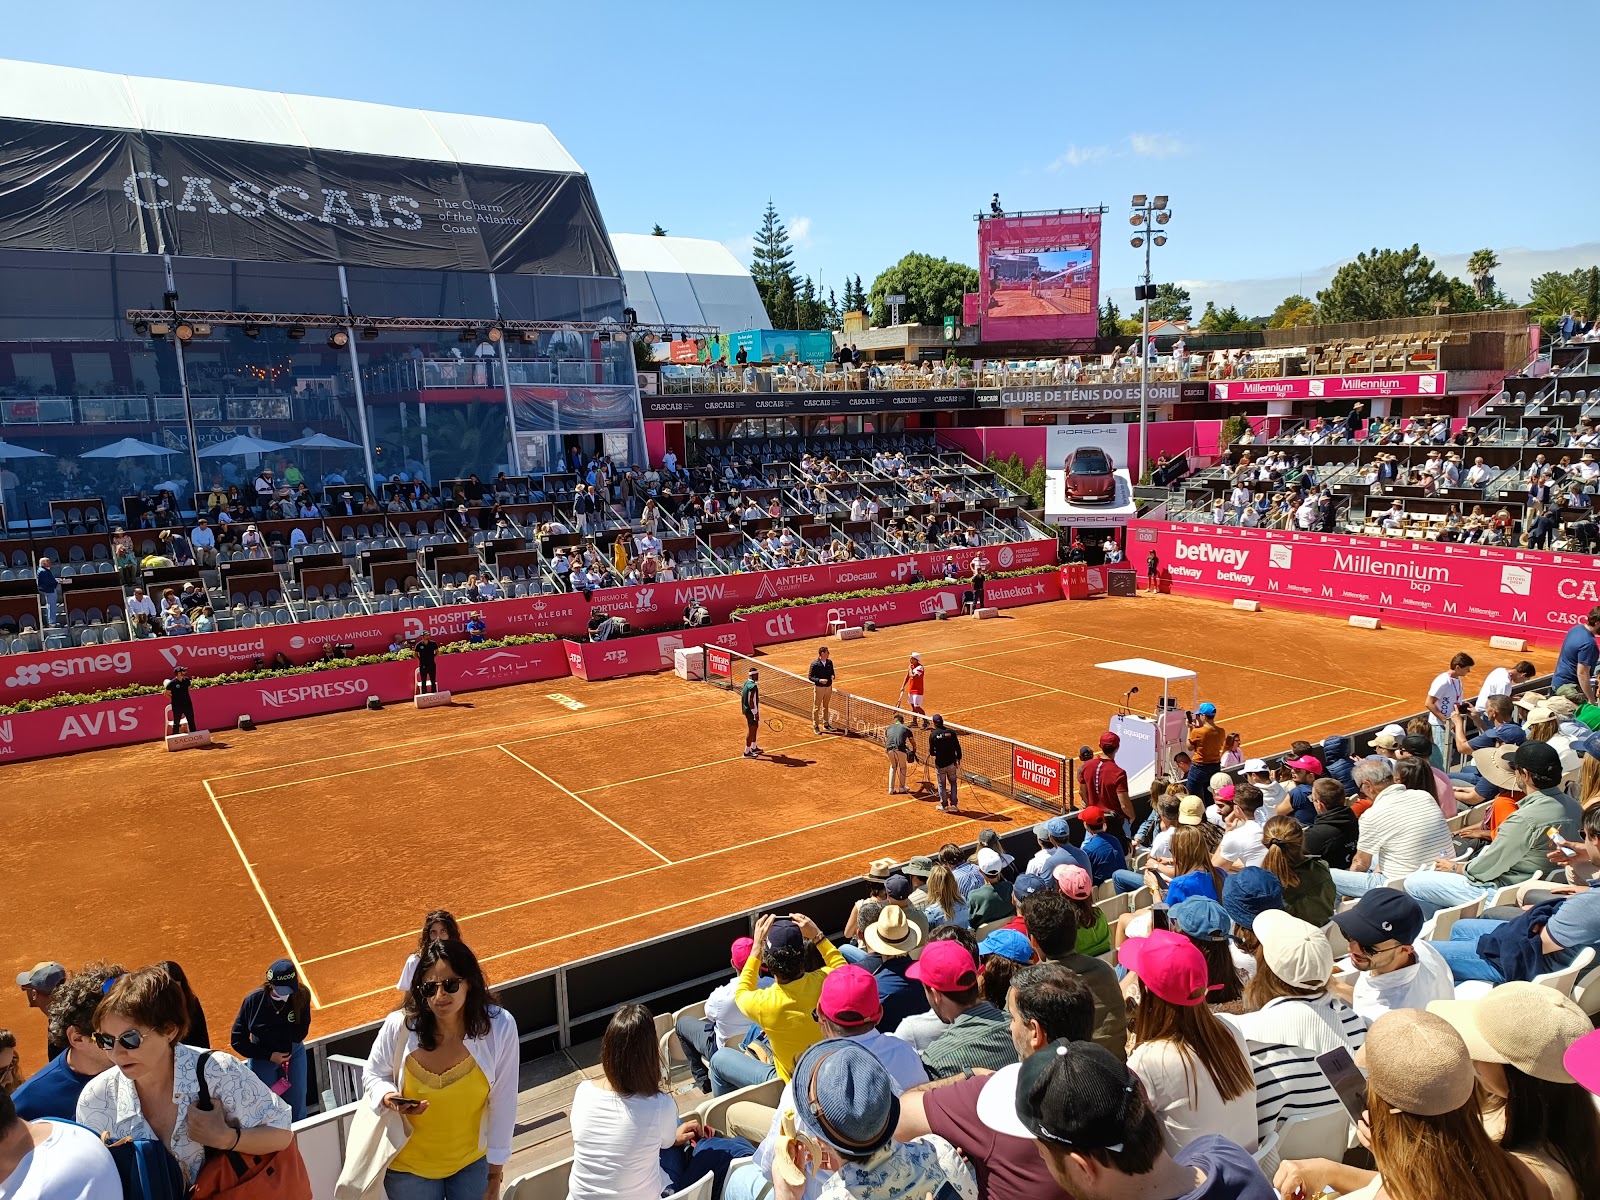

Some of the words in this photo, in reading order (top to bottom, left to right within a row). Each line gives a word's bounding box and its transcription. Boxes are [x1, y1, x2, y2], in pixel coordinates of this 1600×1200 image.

[123, 171, 423, 231] CASCAIS
[434, 198, 460, 209] The
[461, 200, 505, 213] Charm
[438, 211, 452, 221] of
[453, 211, 474, 223] the
[475, 212, 525, 227] Atlantic
[441, 223, 478, 235] Coast
[1242, 382, 1294, 393] Millennium
[1341, 378, 1400, 389] Millennium
[892, 397, 918, 405] CASCAIS
[933, 395, 958, 403] CASCAIS
[976, 394, 999, 403] CASCAIS
[1001, 391, 1042, 403] CLUBE
[1044, 390, 1062, 402] DE
[1063, 387, 1100, 402] TÉNIS
[1102, 388, 1123, 400] DO
[1125, 386, 1180, 400] ESORIL
[650, 402, 683, 411] CASCAIS
[704, 401, 735, 410] CASCAIS
[755, 400, 784, 408] CASCAIS
[803, 399, 831, 407] CASCAIS
[848, 398, 876, 406] CASCAIS
[179, 433, 234, 443] PRTU
[1175, 539, 1250, 570] betway
[1167, 564, 1203, 580] betway
[1333, 549, 1450, 582] Millennium
[775, 573, 816, 586] ANTHEA
[835, 571, 878, 584] JCDecaux
[1216, 569, 1256, 586] betway
[1267, 578, 1279, 591] M
[674, 582, 726, 605] MBW
[986, 585, 1034, 601] Heineken
[1320, 584, 1333, 598] M
[1410, 580, 1431, 594] bcp
[1557, 577, 1600, 603] CA
[593, 593, 619, 603] TURISMO
[620, 592, 629, 600] DE
[919, 594, 943, 614] RFM
[1379, 591, 1393, 605] M
[839, 600, 897, 618] GRAHAM'S
[1443, 599, 1457, 614] M
[1468, 605, 1500, 616] Millennium
[428, 609, 487, 625] HOSPITL
[507, 612, 534, 623] VISTA
[537, 608, 574, 620] ALEGRE
[859, 613, 878, 621] PORT
[1511, 607, 1527, 623] M
[430, 625, 448, 637] DA
[765, 612, 795, 637] ctt
[307, 634, 343, 645] KONICA
[344, 629, 383, 640] MINOLTA
[715, 633, 737, 645] ATP
[186, 638, 265, 658] Vanguard
[229, 651, 265, 661] Properties
[603, 650, 627, 662] ATP
[51, 651, 132, 678] smeg
[460, 659, 542, 678] AZIMUT
[486, 671, 520, 680] YACHTS
[256, 678, 369, 708] NESPRESSO
[1440, 696, 1451, 717] COOR
[58, 706, 139, 741] AVIS
[174, 734, 204, 745] SACOOR
[1123, 728, 1151, 741] aquapor
[0, 745, 15, 755] AL
[1015, 754, 1057, 779] Emirates
[1021, 769, 1031, 781] FLY
[1031, 772, 1051, 788] BETTER
